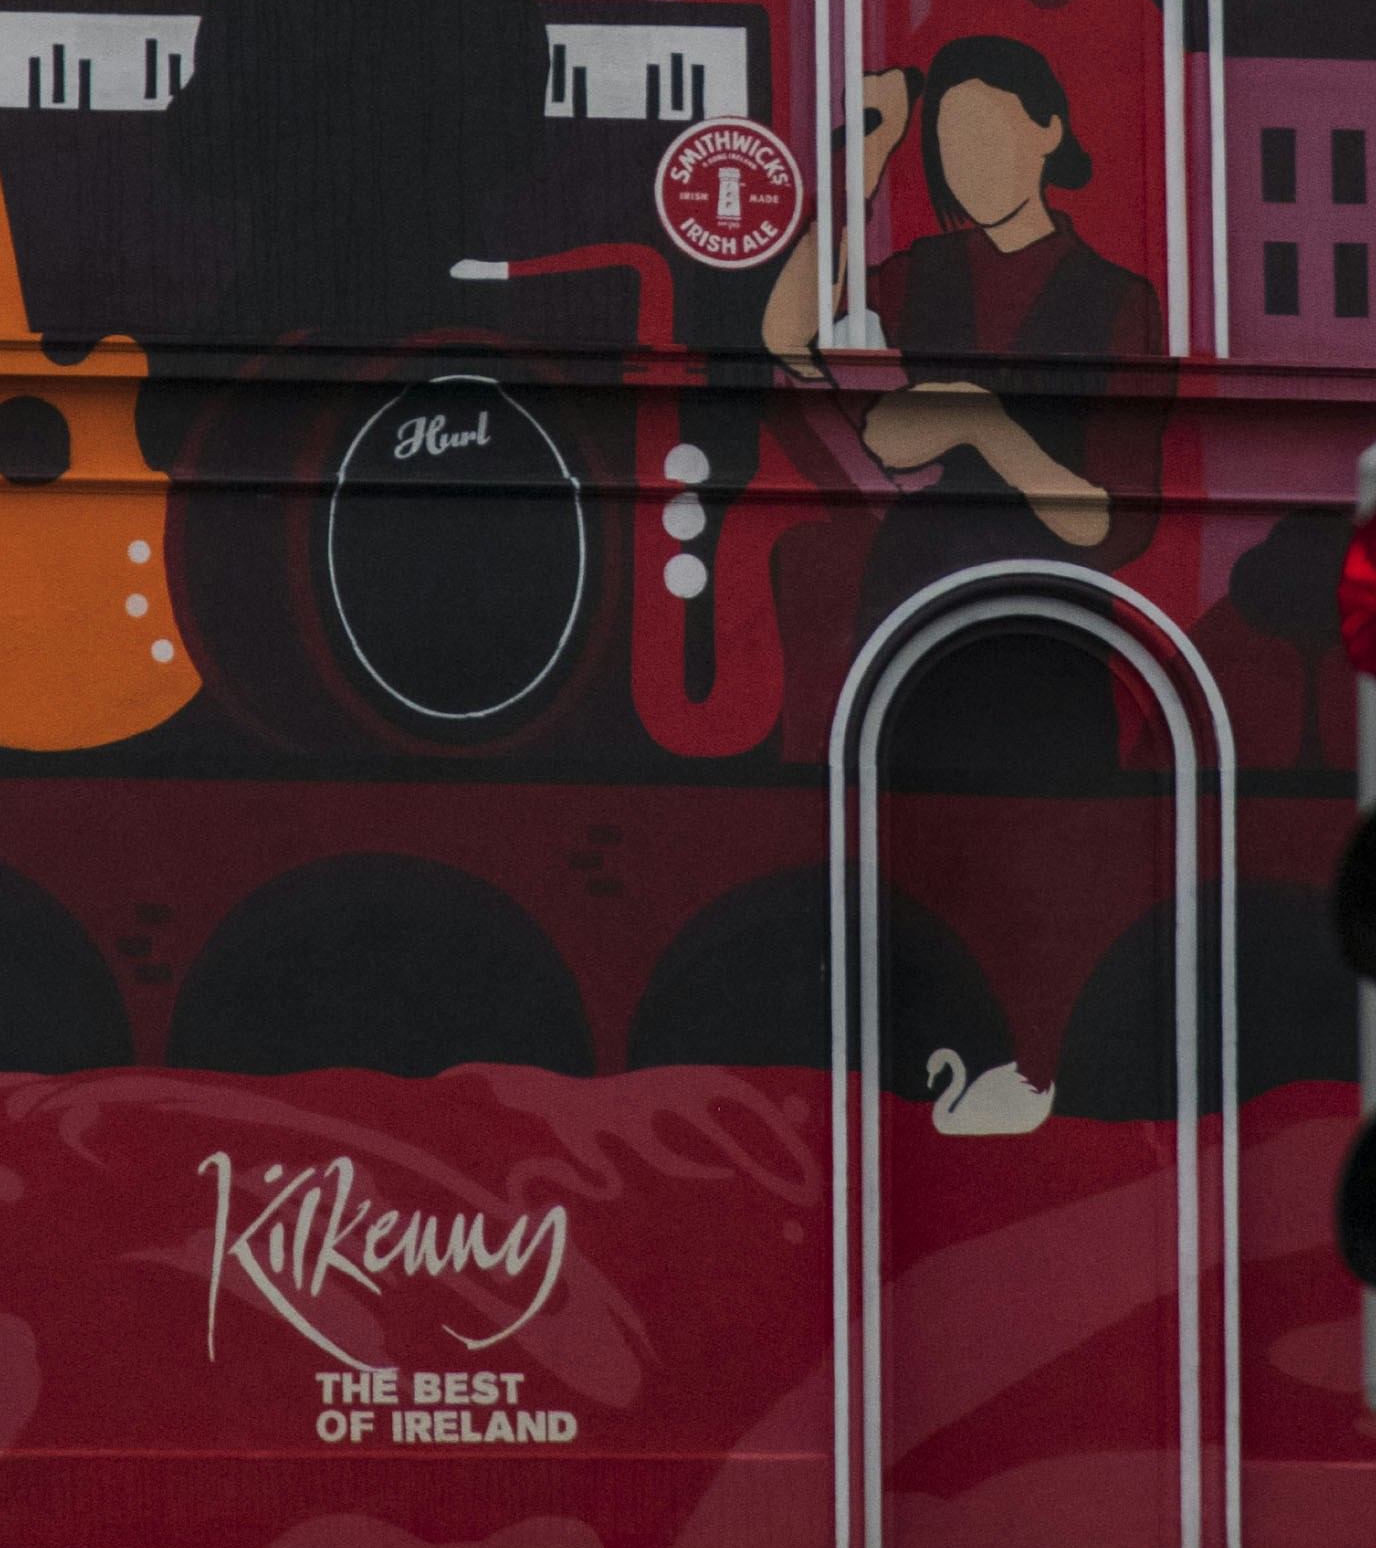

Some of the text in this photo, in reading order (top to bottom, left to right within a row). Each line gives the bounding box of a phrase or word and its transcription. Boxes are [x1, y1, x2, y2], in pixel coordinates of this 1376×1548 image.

[749, 194, 780, 204] MADE
[680, 217, 778, 255] IRISH ALE
[393, 410, 491, 460] Hurl
[197, 1151, 568, 1372] Kilkenny
[315, 1371, 525, 1405] THE BEST
[315, 1409, 578, 1443] OF IRELAND
